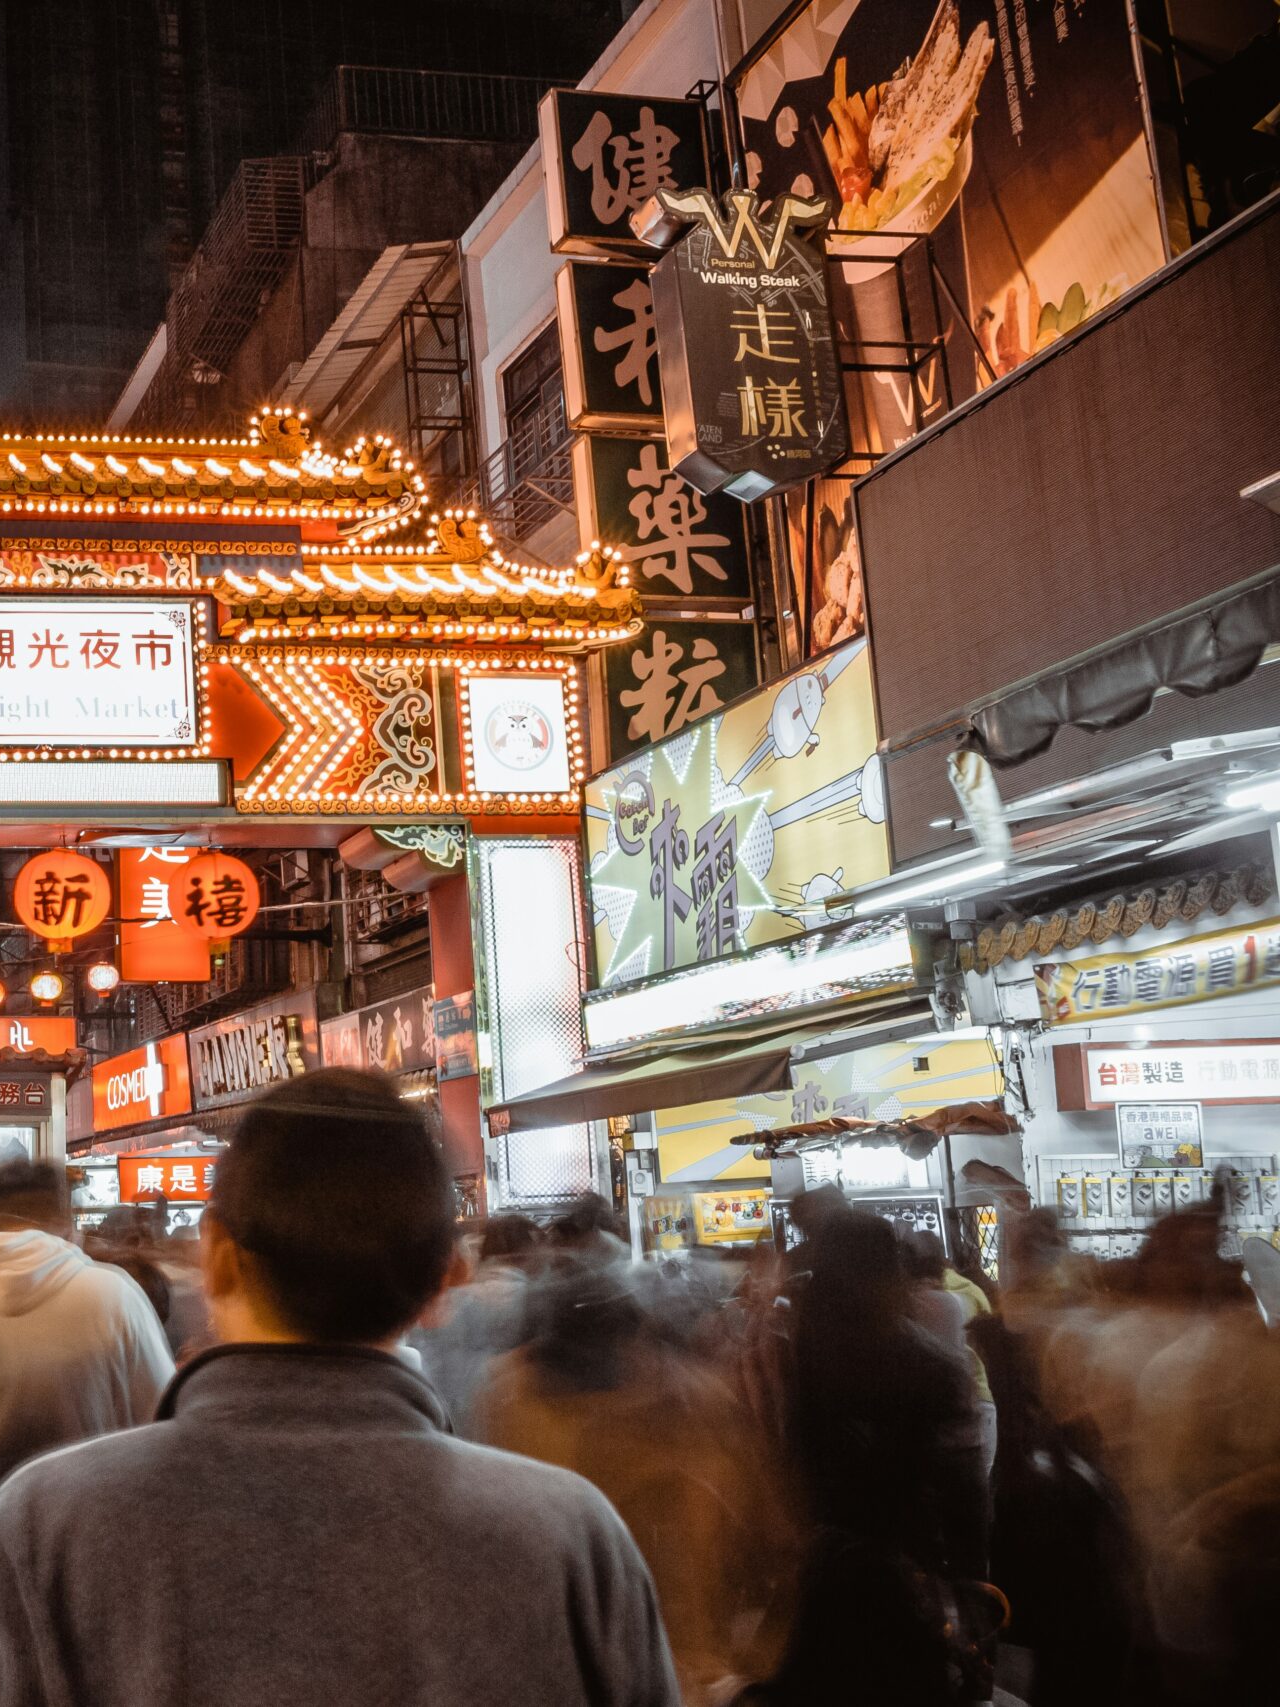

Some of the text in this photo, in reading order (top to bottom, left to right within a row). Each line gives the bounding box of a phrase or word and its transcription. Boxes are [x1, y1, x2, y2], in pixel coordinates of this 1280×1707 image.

[711, 258, 755, 269] Personal
[701, 271, 800, 288] Walking Steak
[730, 304, 808, 437] 走樣
[75, 696, 179, 719] Market
[33, 870, 89, 927] 新
[185, 874, 248, 927] 禧
[1098, 1061, 1184, 1086] 台灣製造
[107, 1067, 148, 1110] COSMED
